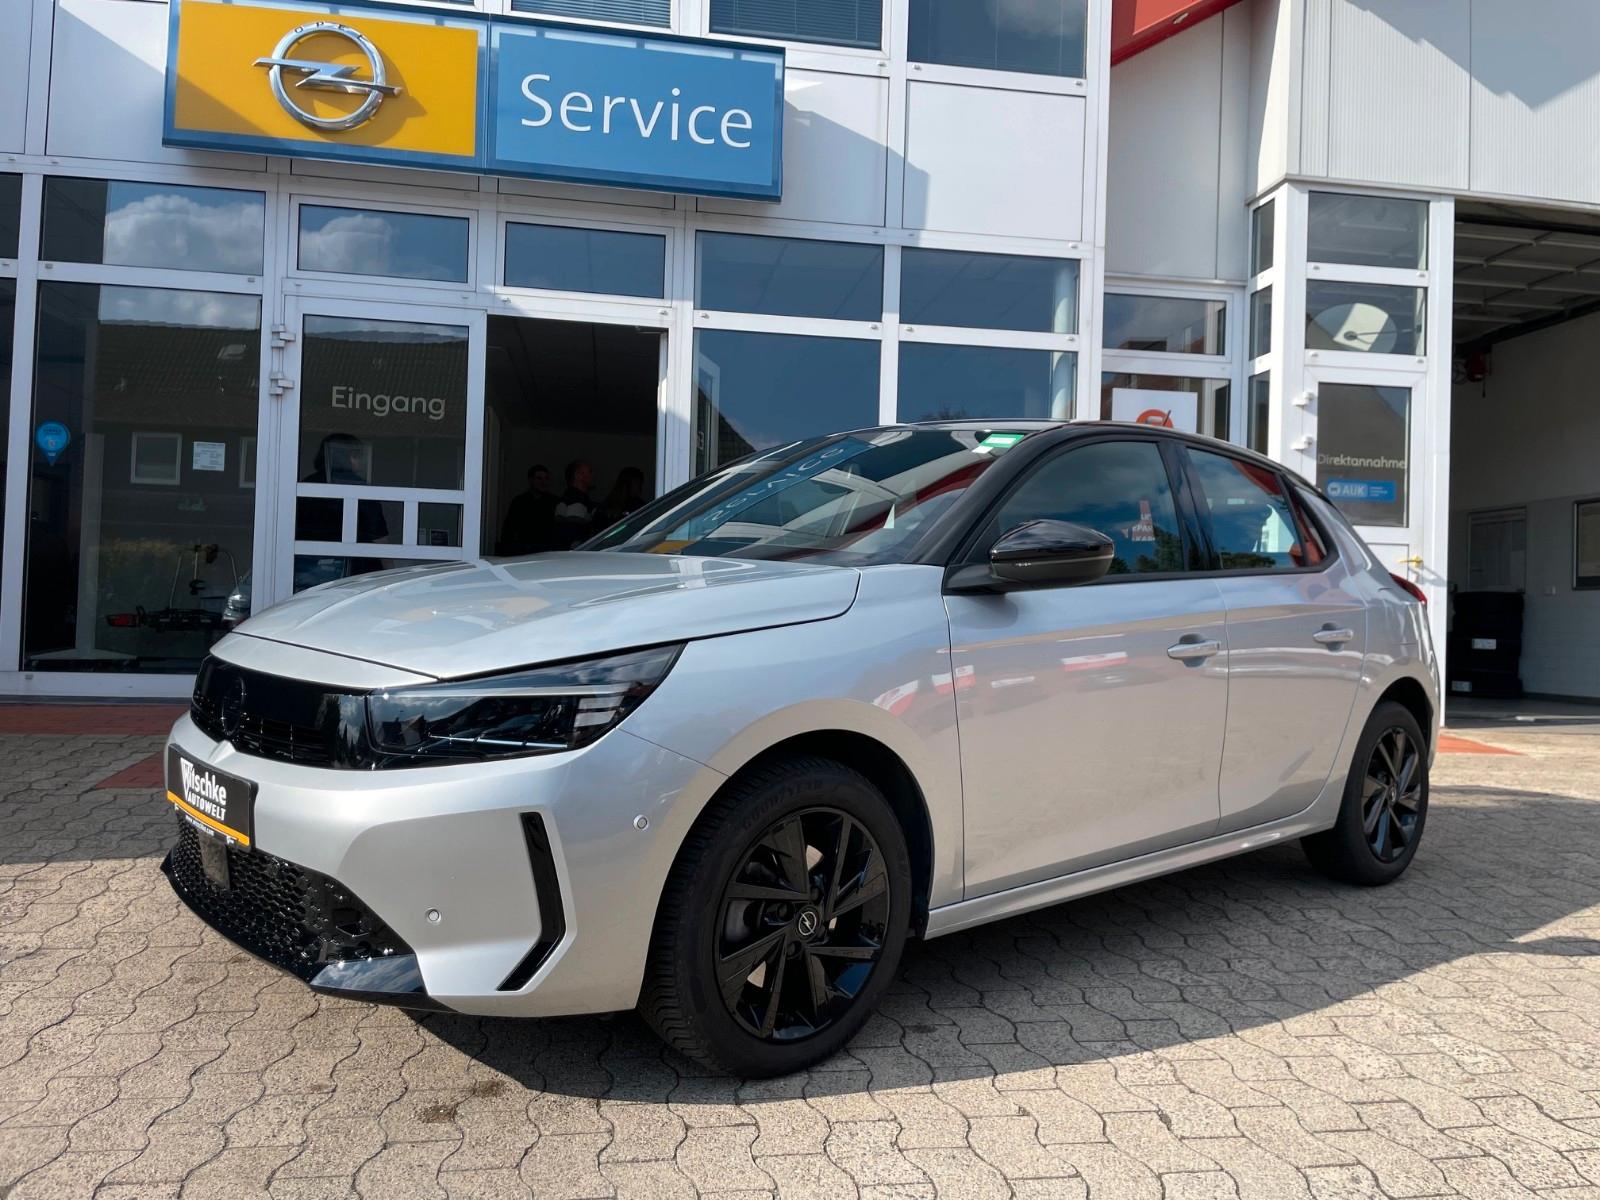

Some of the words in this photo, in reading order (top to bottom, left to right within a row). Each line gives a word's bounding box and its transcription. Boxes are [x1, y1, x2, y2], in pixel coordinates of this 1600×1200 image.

[521, 73, 753, 148] Service
[331, 385, 446, 420] Eingang
[1317, 454, 1406, 469] Direktannahme
[186, 791, 226, 821] AUTOWELT
